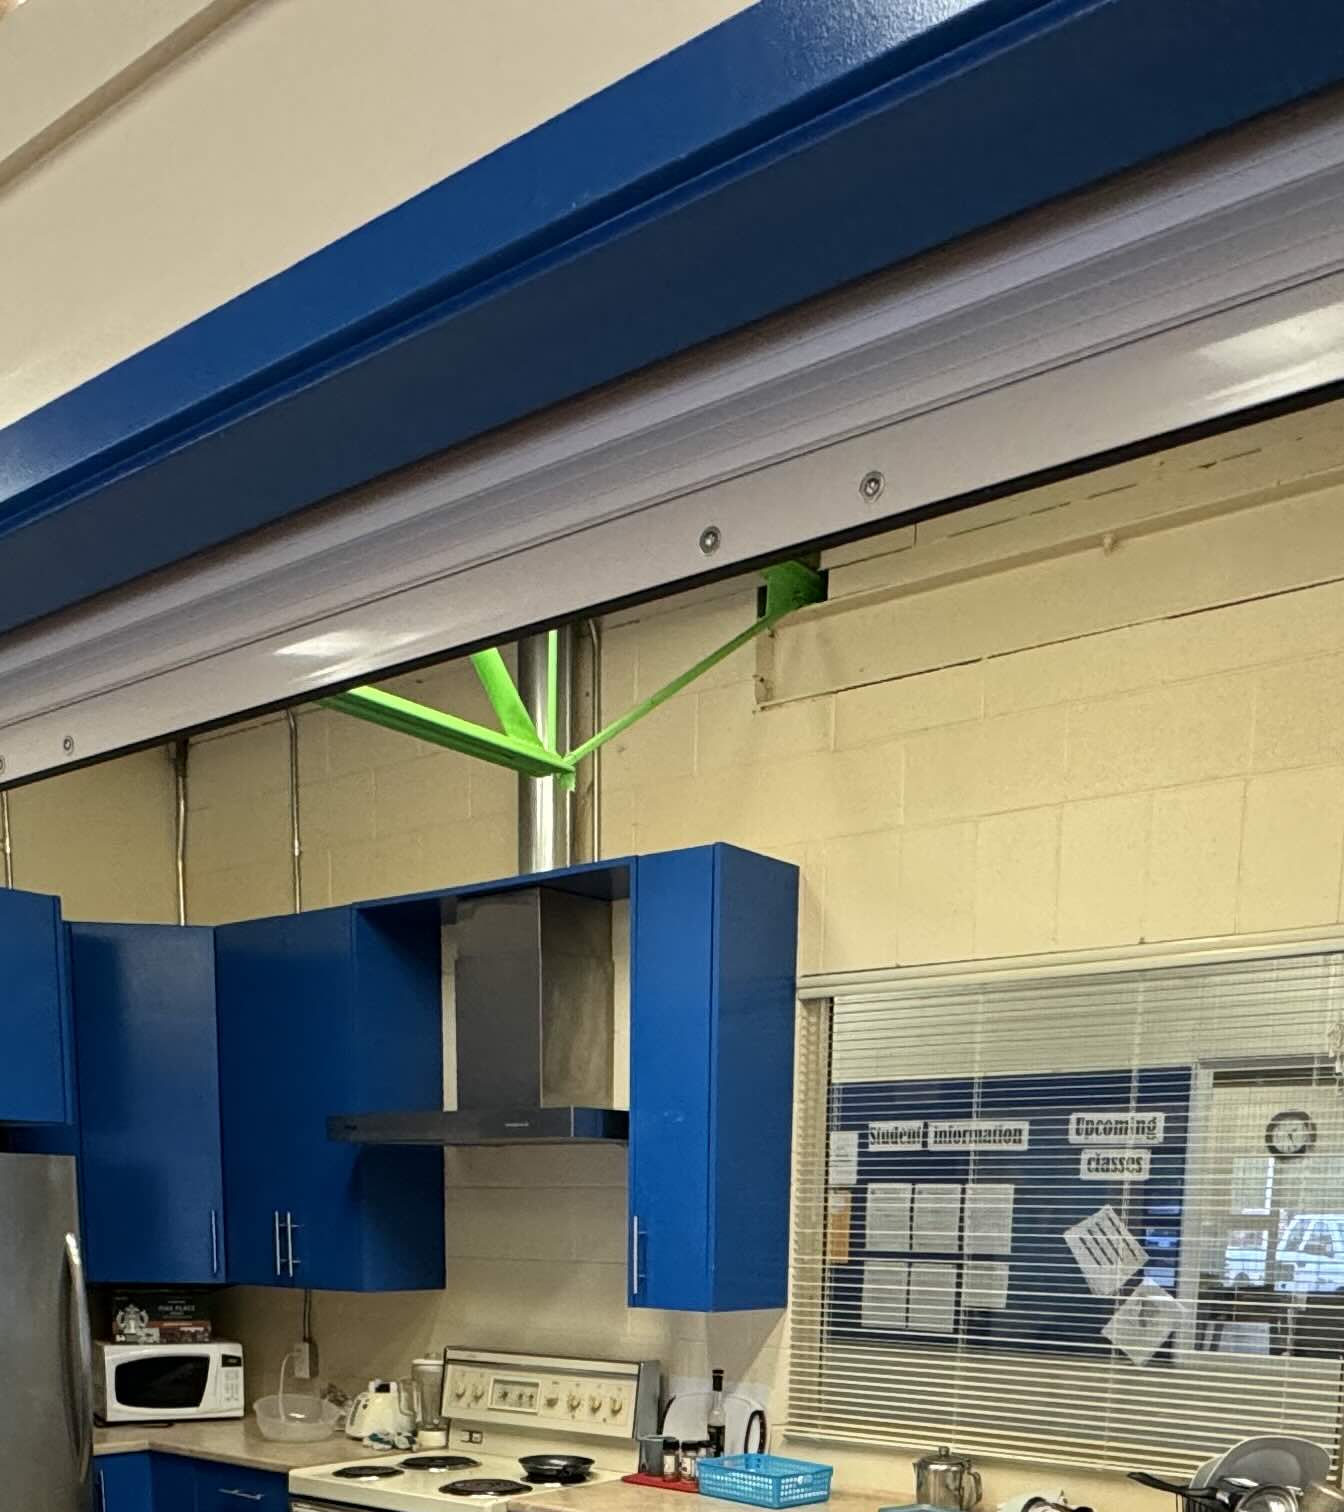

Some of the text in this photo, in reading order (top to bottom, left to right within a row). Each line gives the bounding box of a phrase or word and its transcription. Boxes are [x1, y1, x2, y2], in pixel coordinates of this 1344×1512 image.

[870, 1124, 1024, 1146] Student information
[1076, 1117, 1158, 1140] Upcoming
[1087, 1152, 1144, 1173] classes
